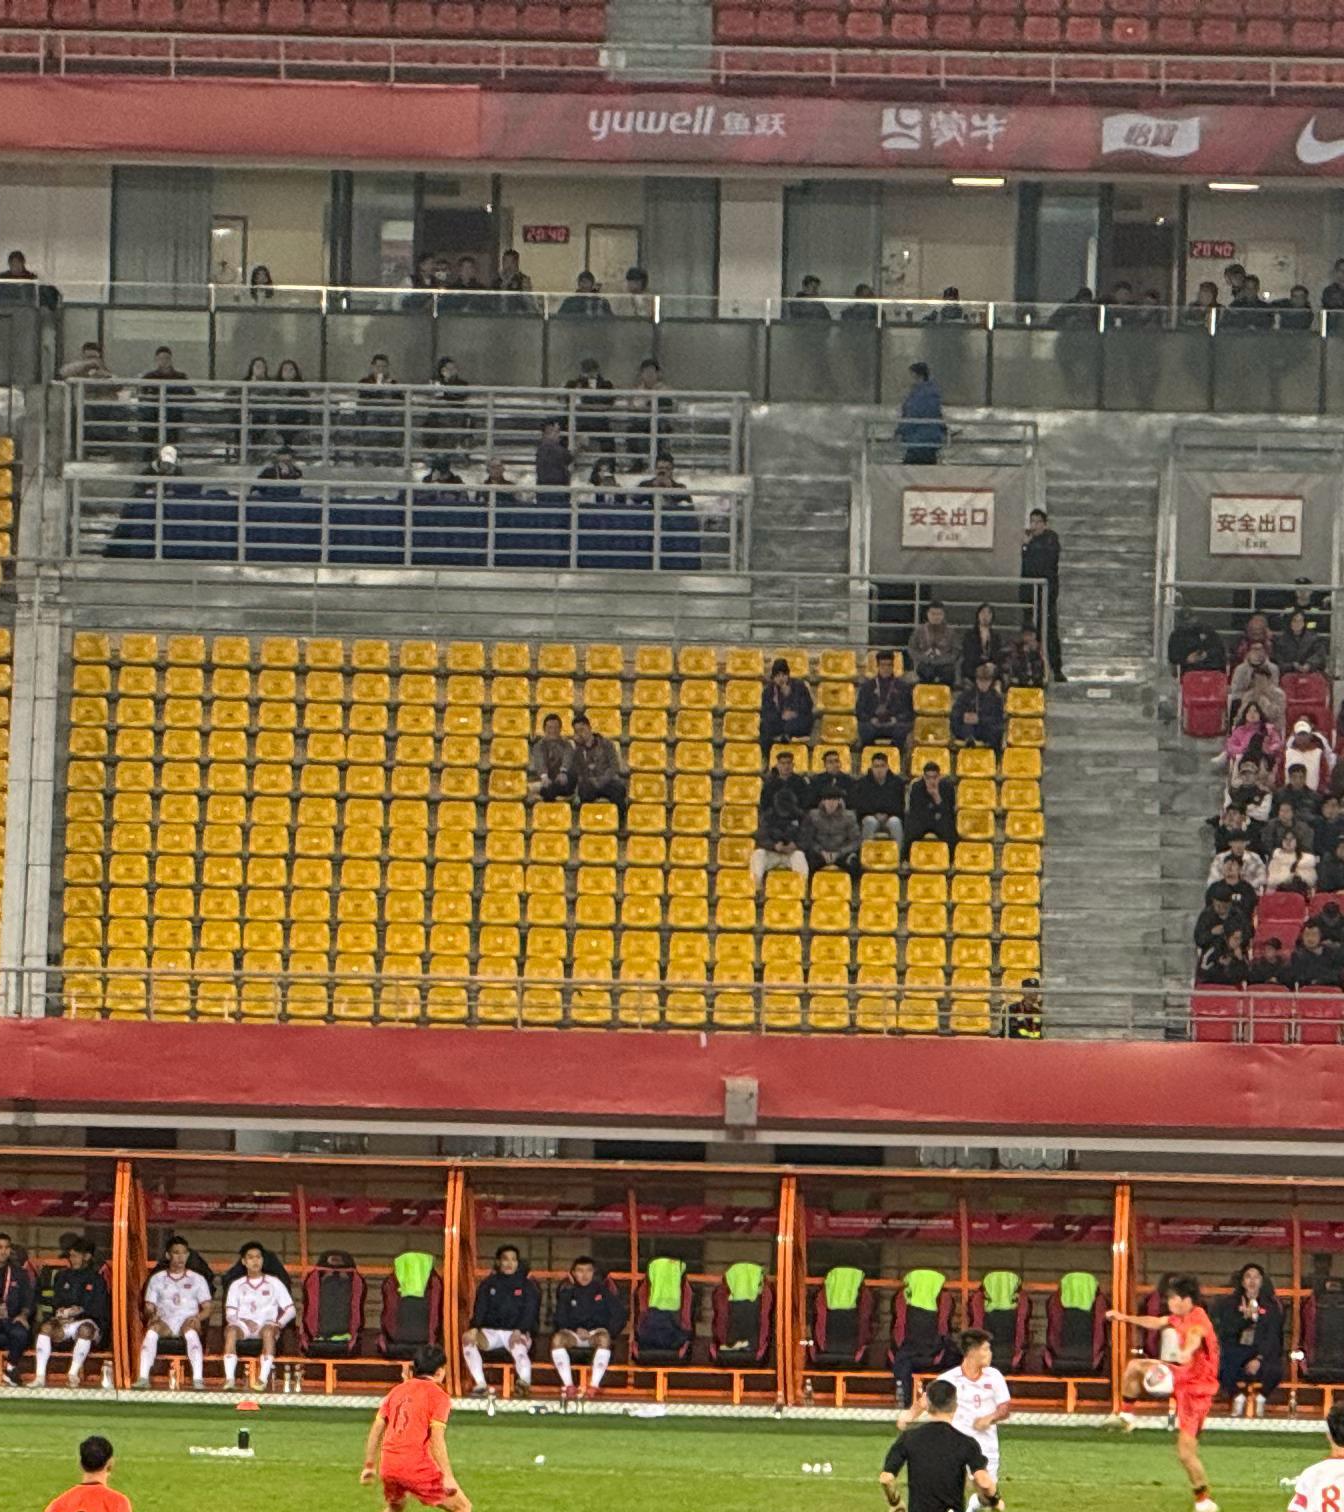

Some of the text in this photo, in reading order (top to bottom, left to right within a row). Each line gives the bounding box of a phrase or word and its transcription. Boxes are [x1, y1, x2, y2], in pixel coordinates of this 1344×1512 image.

[587, 105, 787, 141] yuwell 鱼跃
[928, 109, 1008, 151] 蒙牛
[909, 507, 989, 527] 安全出口
[1216, 513, 1297, 533] 安全出口
